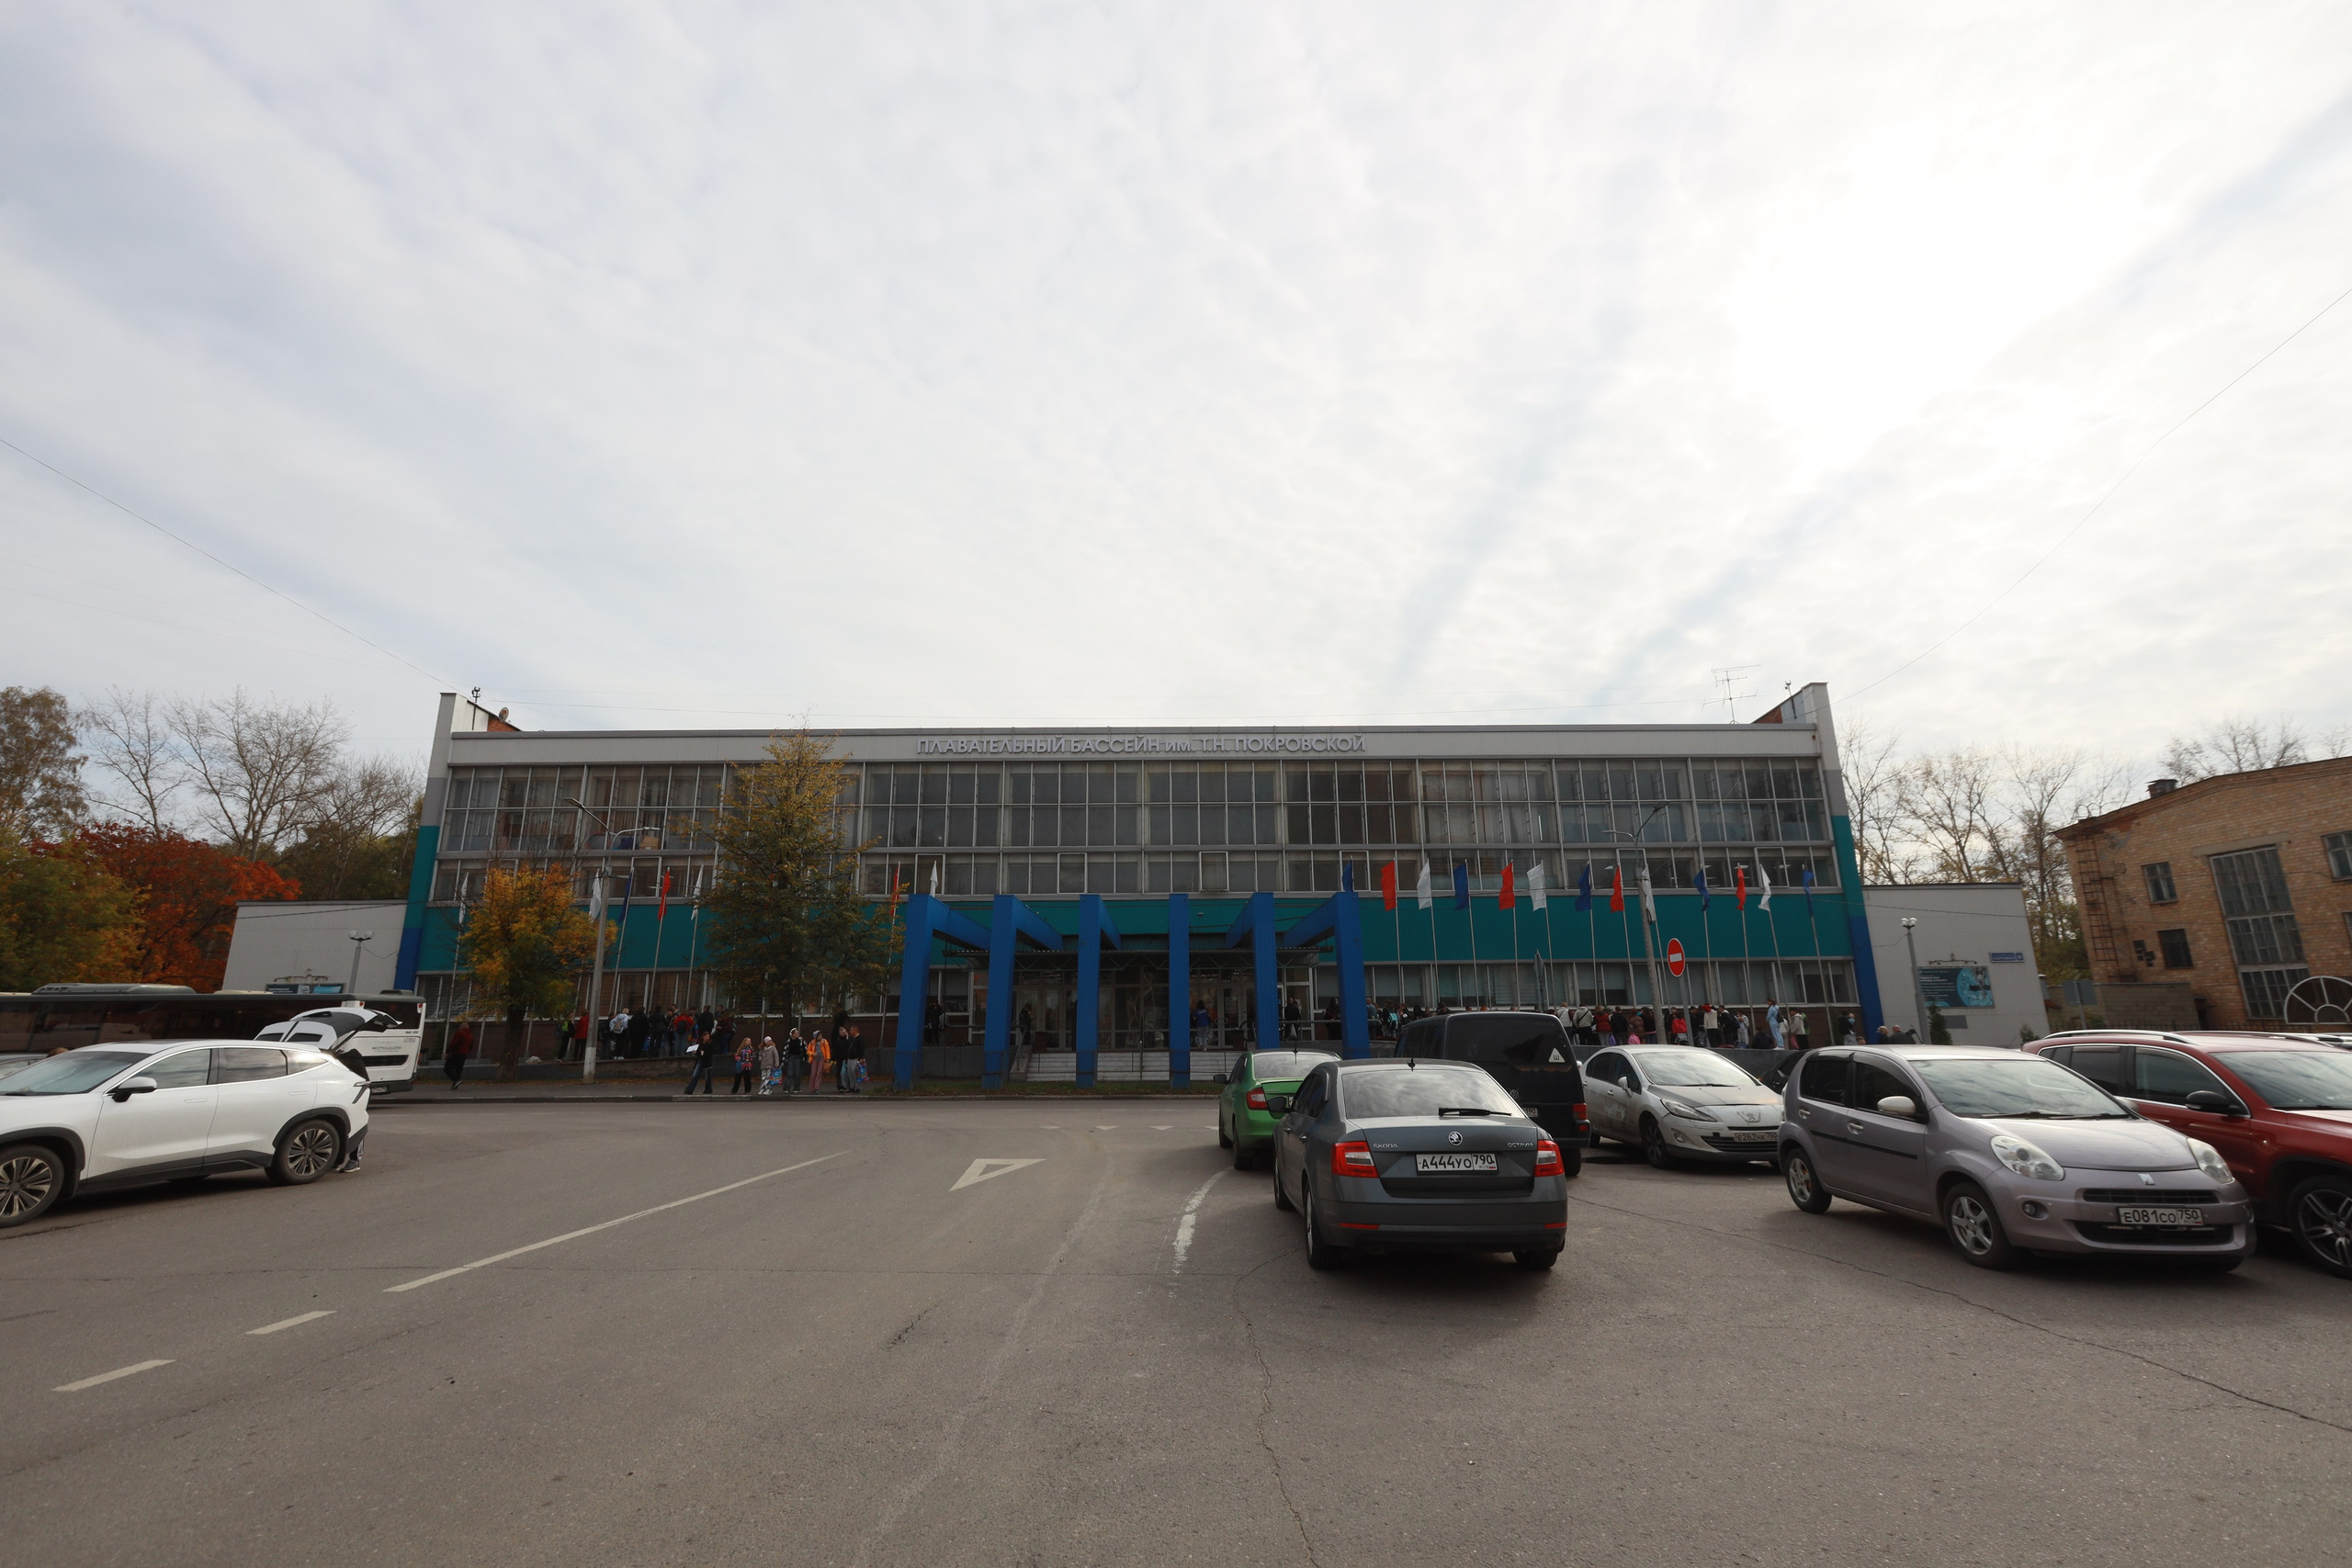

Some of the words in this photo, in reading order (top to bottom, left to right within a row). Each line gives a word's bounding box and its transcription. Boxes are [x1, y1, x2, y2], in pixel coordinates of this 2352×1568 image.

[917, 735, 1066, 754] ПЛАВАТЕЛЬНЫЙ
[1070, 735, 1160, 753] БАССЕЙН
[1201, 738, 1231, 753] Т.Н.
[1235, 735, 1366, 752] ПОКРОВСКОЙ
[1421, 1155, 1472, 1169] А444УО
[1473, 1155, 1493, 1165] 790
[2123, 1209, 2177, 1224] Е081СО
[2177, 1209, 2199, 1220] 750
